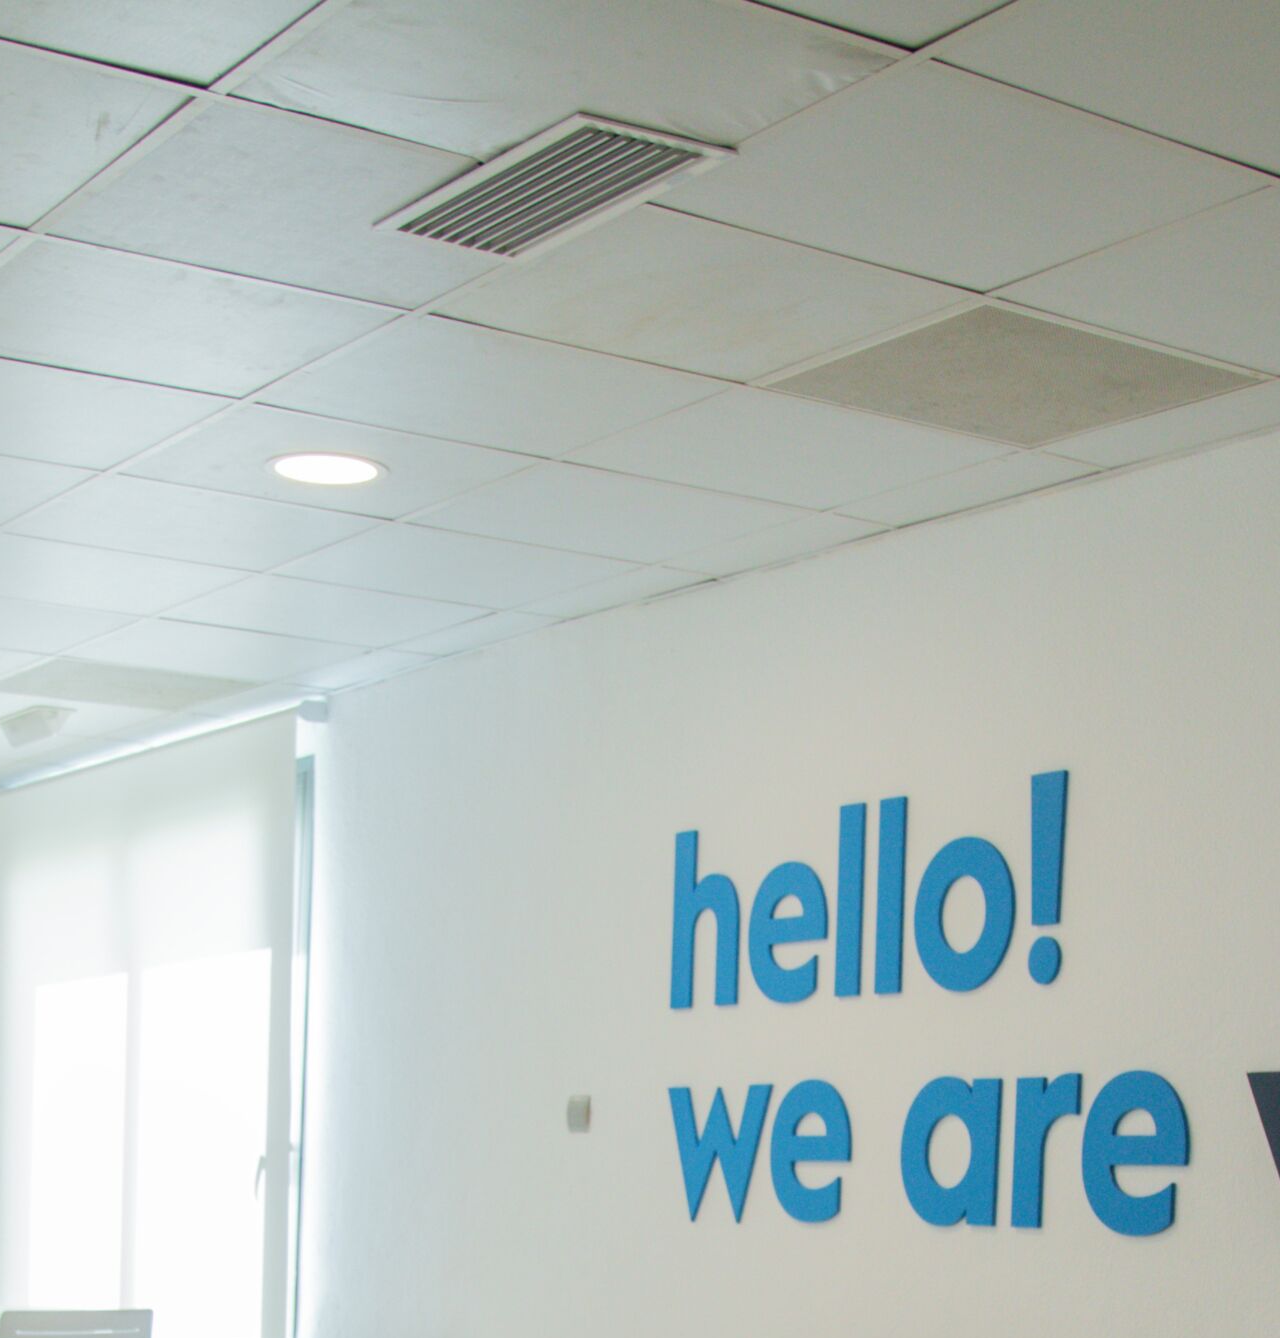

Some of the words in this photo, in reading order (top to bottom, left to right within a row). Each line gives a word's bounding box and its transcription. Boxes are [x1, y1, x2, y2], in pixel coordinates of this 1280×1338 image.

[670, 770, 1068, 1009] hello!
[668, 1079, 851, 1223] we
[900, 1070, 1190, 1236] are
